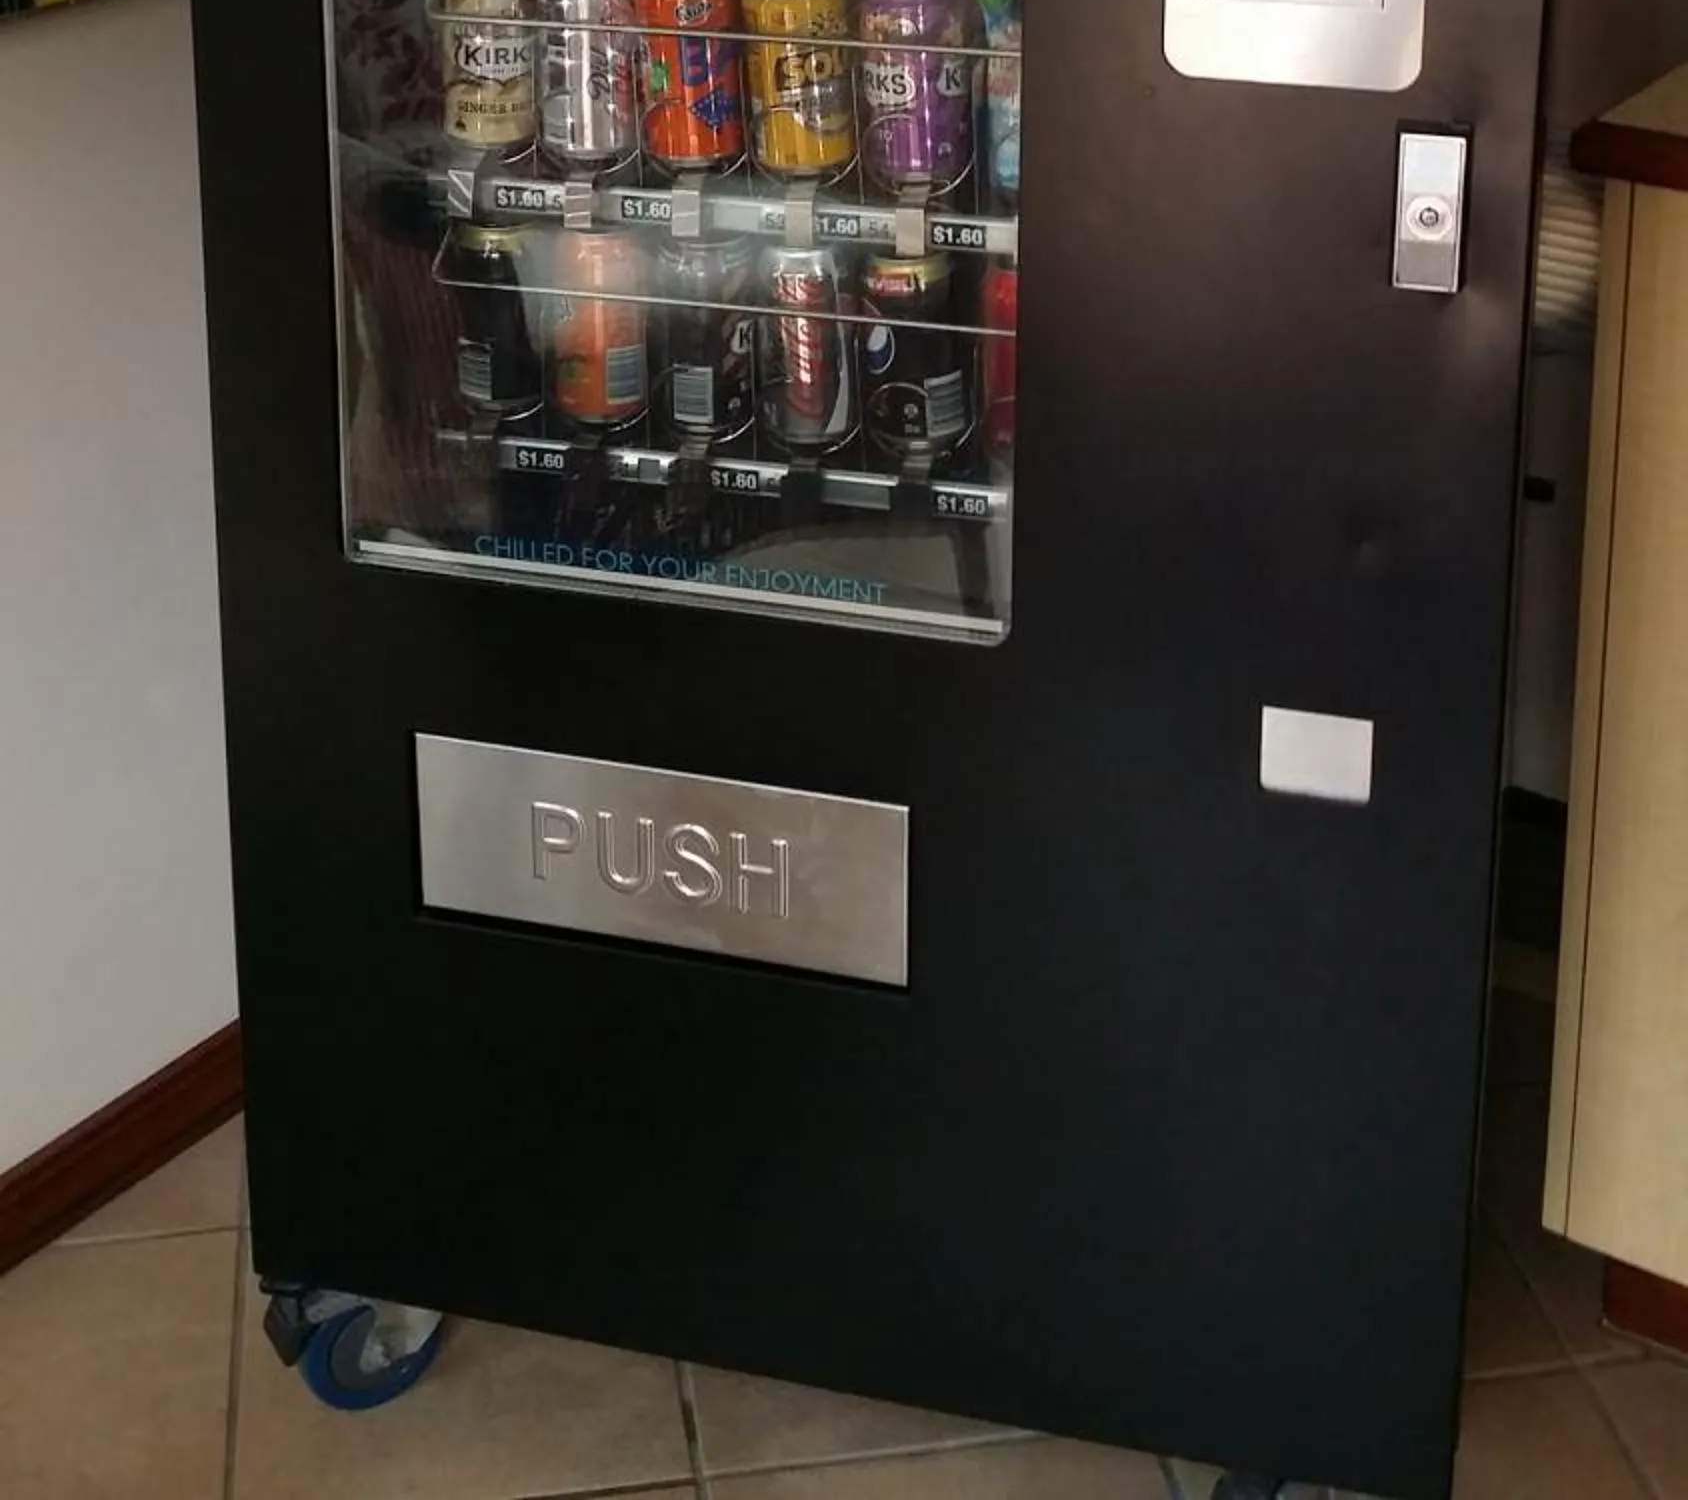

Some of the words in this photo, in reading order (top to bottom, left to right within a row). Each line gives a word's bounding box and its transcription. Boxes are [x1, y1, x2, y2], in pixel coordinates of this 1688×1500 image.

[622, 200, 672, 219] $1.60
[932, 225, 984, 247] $1.60
[517, 450, 564, 470] $1.60
[710, 469, 758, 490] $1.60
[936, 496, 988, 516] $1.60
[474, 534, 575, 567] CHILLED
[580, 546, 634, 575] FOR
[640, 554, 718, 585] YOUR
[725, 564, 888, 606] ENJOYMENT
[530, 800, 790, 920] PUSH
